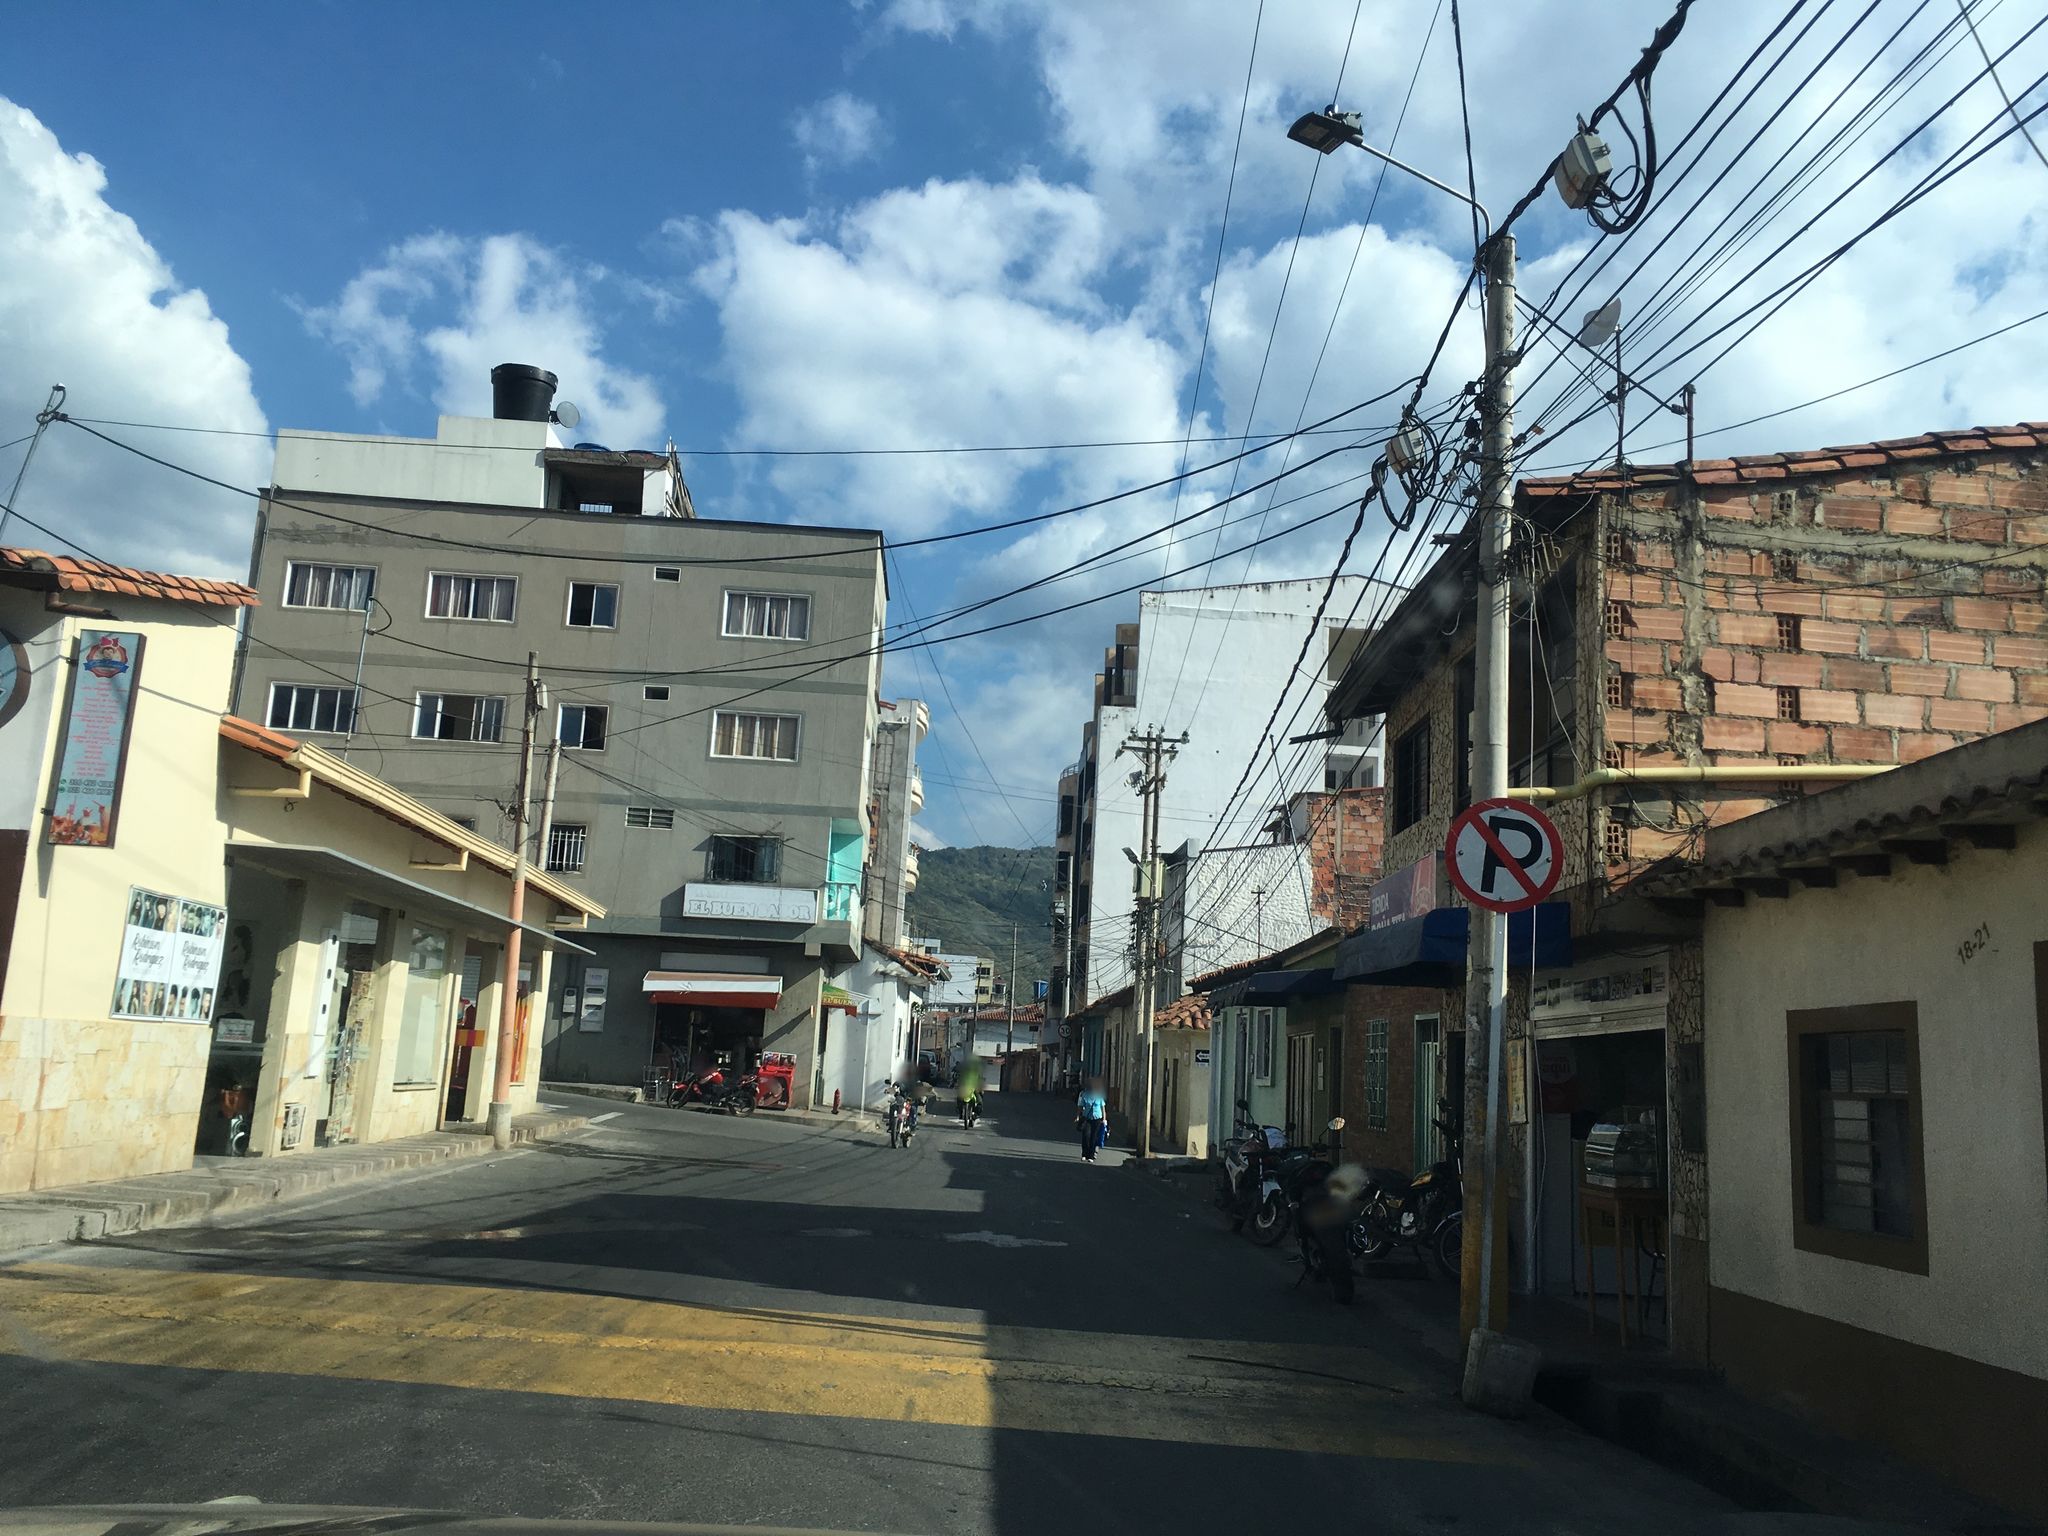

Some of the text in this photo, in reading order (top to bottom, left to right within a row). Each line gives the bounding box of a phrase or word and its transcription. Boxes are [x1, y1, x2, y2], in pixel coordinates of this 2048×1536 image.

[1481, 815, 1543, 894] P
[689, 900, 711, 915] EL
[710, 901, 755, 917] BUEN
[1958, 921, 1990, 965] 18-21
